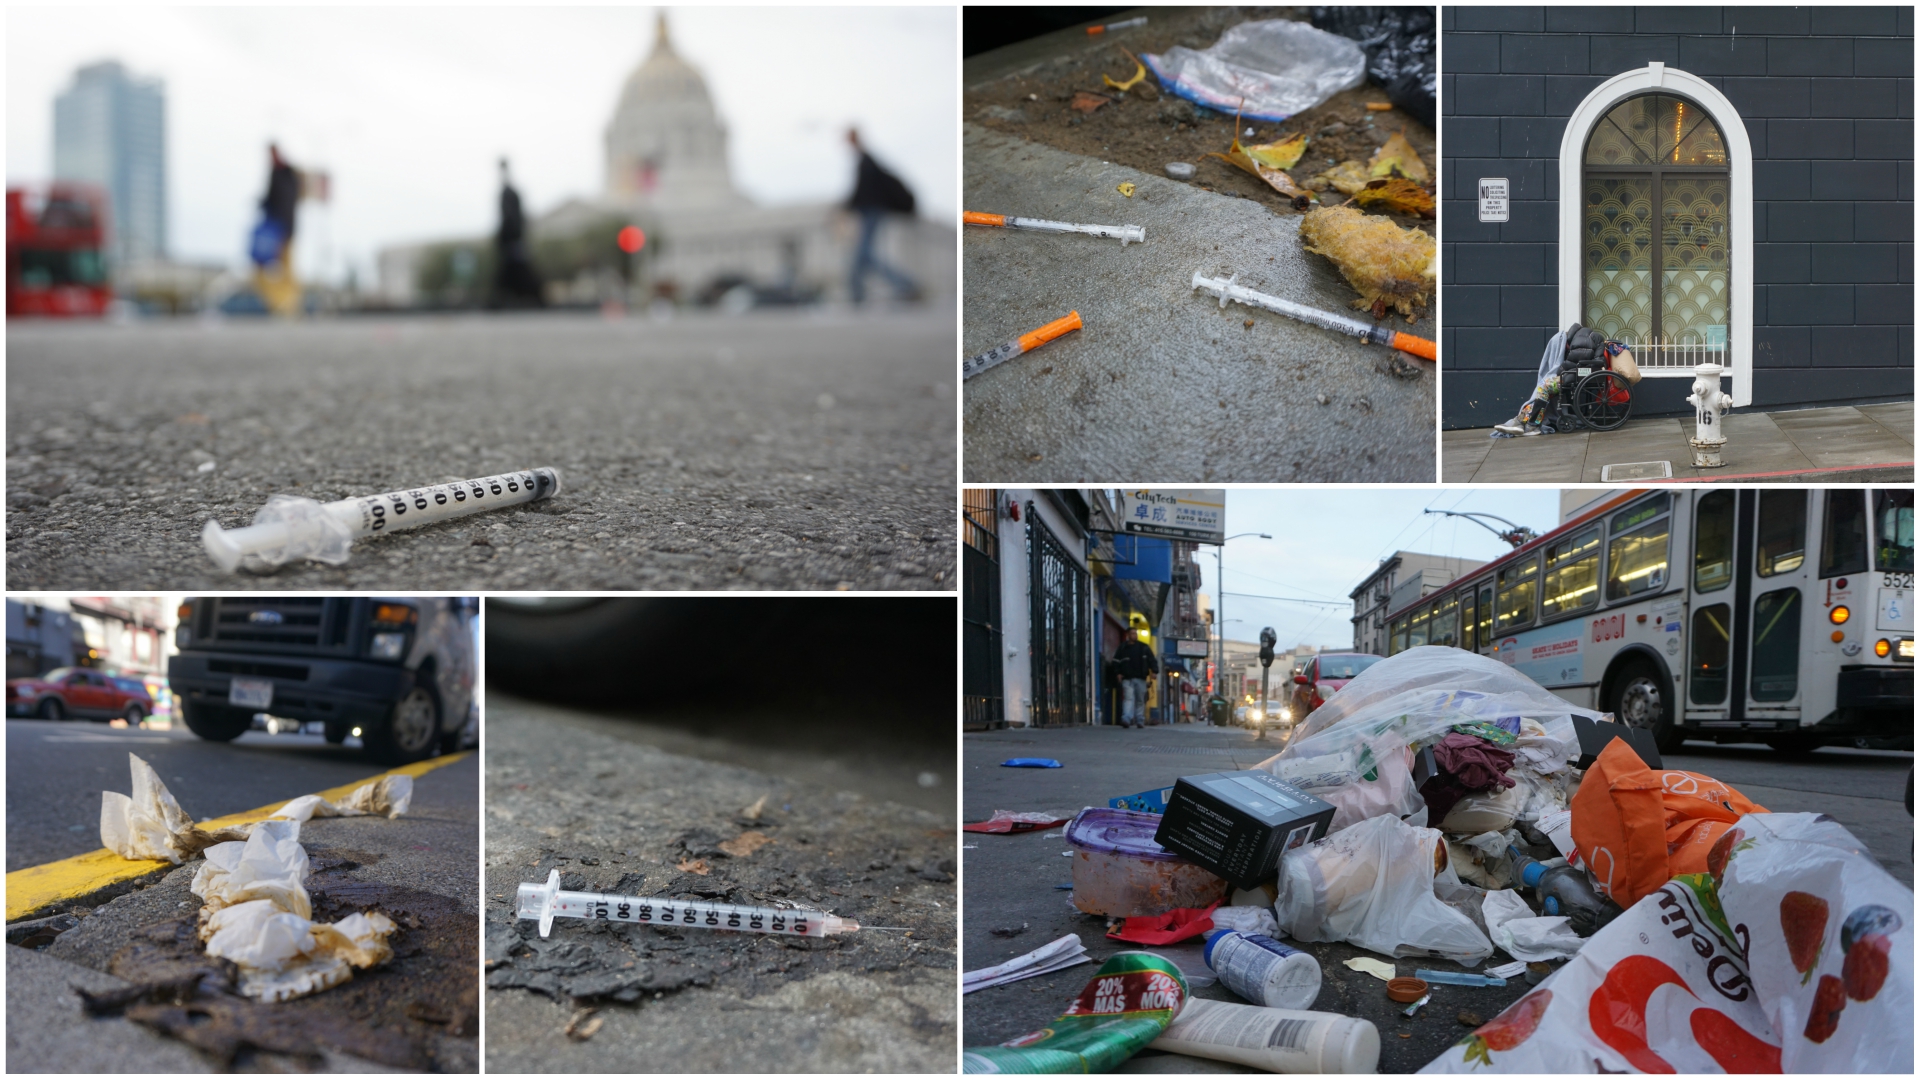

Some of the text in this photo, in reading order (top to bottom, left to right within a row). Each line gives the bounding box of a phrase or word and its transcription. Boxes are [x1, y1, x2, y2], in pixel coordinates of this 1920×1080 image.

[1481, 185, 1489, 199] NO
[1699, 410, 1712, 425] 16
[408, 490, 428, 510] 80
[366, 498, 386, 531] 100
[1134, 503, 1167, 522] 卓成
[1883, 573, 1914, 589] 552
[1221, 848, 1233, 869] YOUR
[1227, 832, 1246, 872] EVERYDAY
[1232, 843, 1249, 875] INSTANT
[1238, 828, 1262, 878] INSPIRATION
[617, 902, 630, 919] 90
[639, 904, 652, 920] 80
[661, 905, 674, 921] 70
[683, 907, 697, 924] 60
[705, 910, 719, 926] 50
[727, 912, 741, 927] 40
[750, 912, 763, 929] 30
[772, 914, 785, 931] 20
[794, 916, 807, 933] 10
[1095, 977, 1124, 996] 20%
[1147, 973, 1180, 997] 20%
[1092, 995, 1126, 1013] MAS
